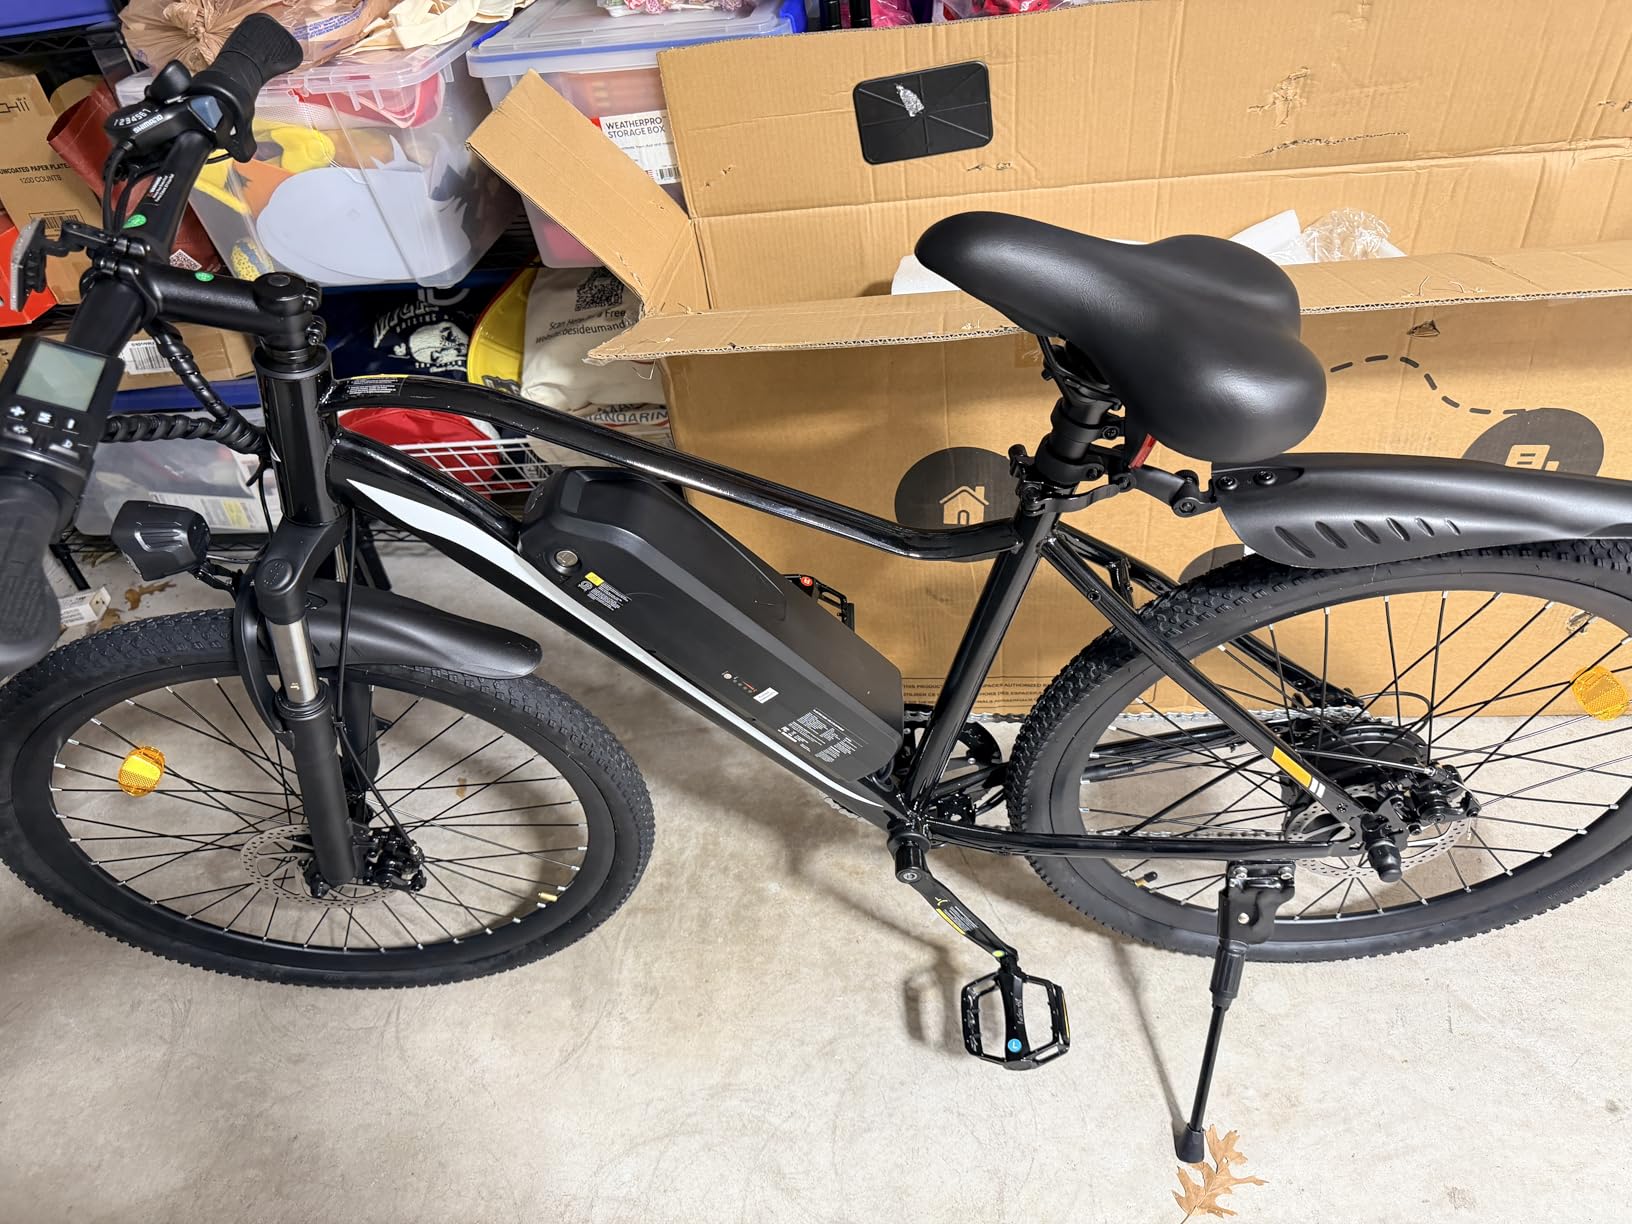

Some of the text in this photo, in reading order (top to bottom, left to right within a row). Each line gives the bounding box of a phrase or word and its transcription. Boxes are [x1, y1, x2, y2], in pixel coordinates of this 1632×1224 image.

[605, 116, 663, 131] WEATHERPRO
[607, 125, 666, 139] STORAGE BOX
[31, 163, 50, 172] PAPER
[604, 309, 627, 319] Free
